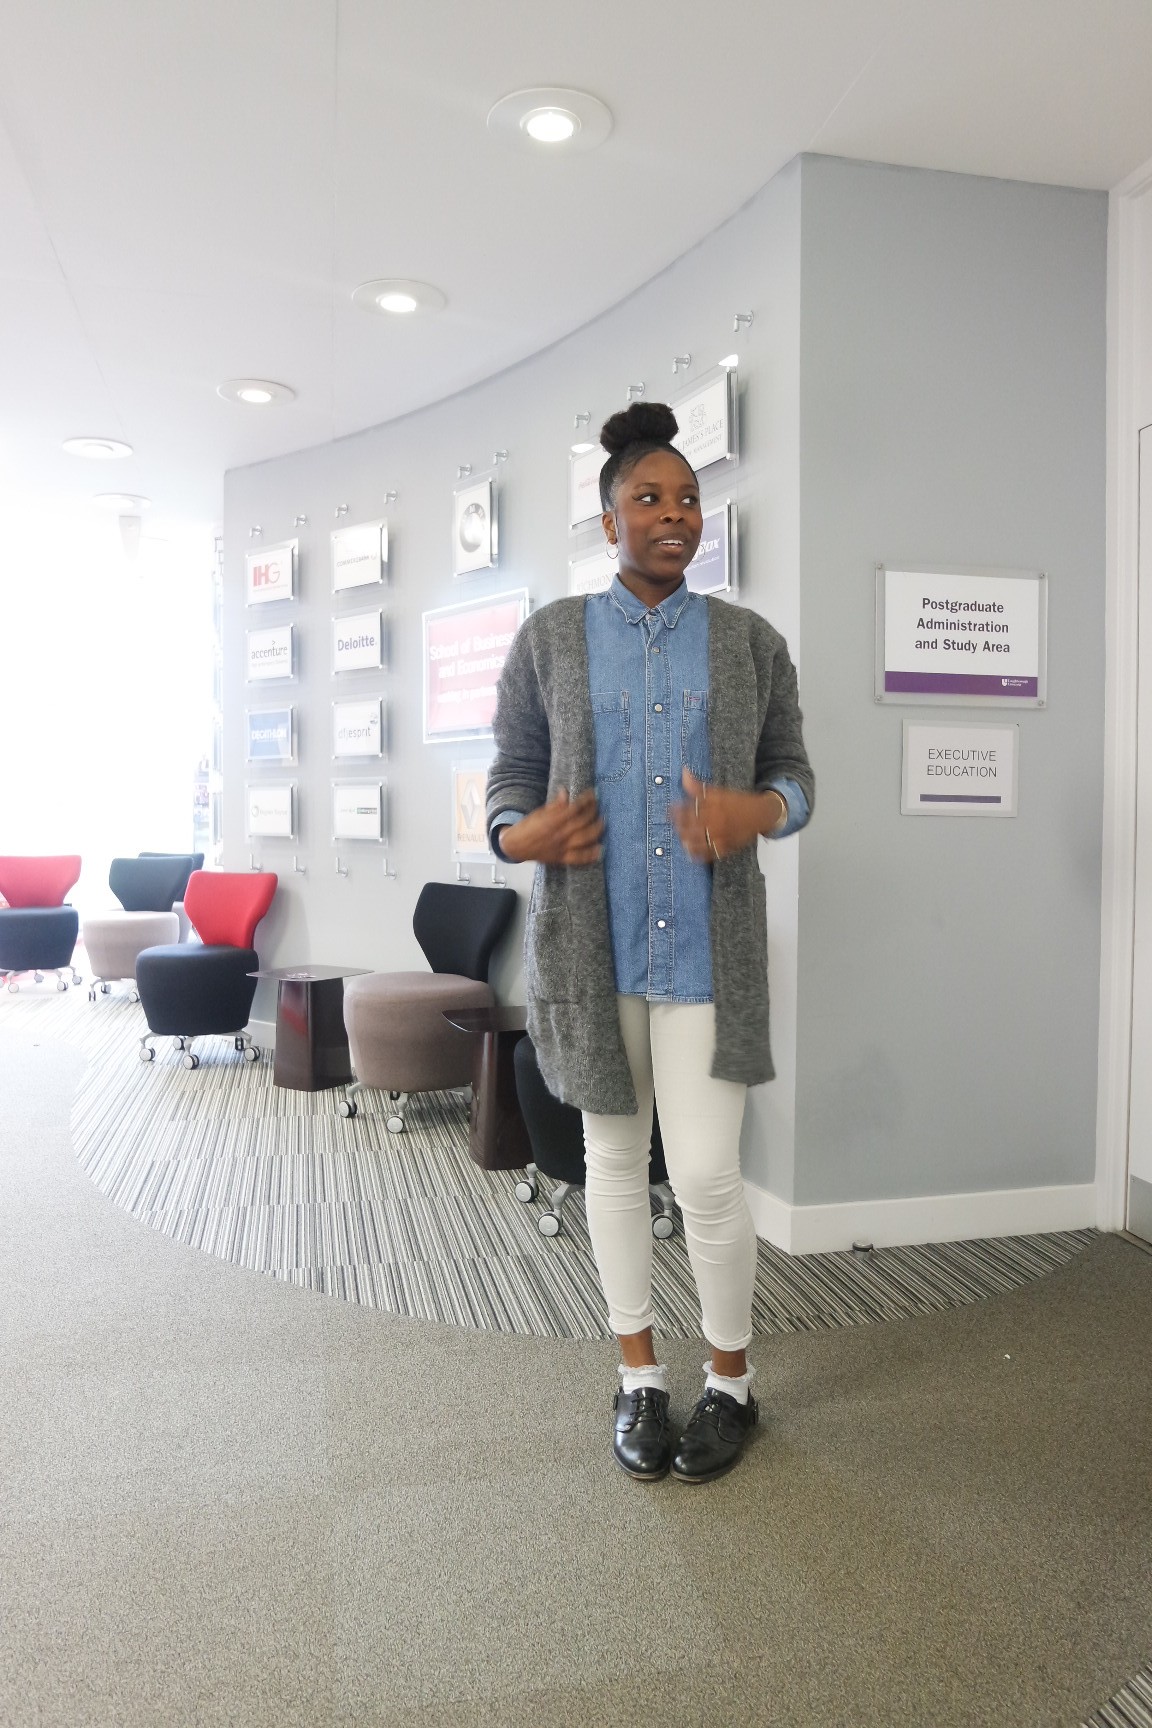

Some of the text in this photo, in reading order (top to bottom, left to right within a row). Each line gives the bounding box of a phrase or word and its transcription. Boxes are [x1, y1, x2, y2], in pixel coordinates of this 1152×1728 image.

[253, 562, 281, 587] IHG
[923, 598, 1003, 613] Postgraduate
[917, 618, 1008, 633] Administration
[251, 646, 289, 660] accenture
[429, 632, 515, 661] School of Business
[915, 639, 1009, 653] and Study Area
[438, 654, 505, 679] and Economics
[251, 728, 288, 741] DECATHLON
[929, 749, 996, 761] EXECUTIVE
[927, 765, 996, 777] EDUCATION
[456, 833, 486, 843] RENAULT
